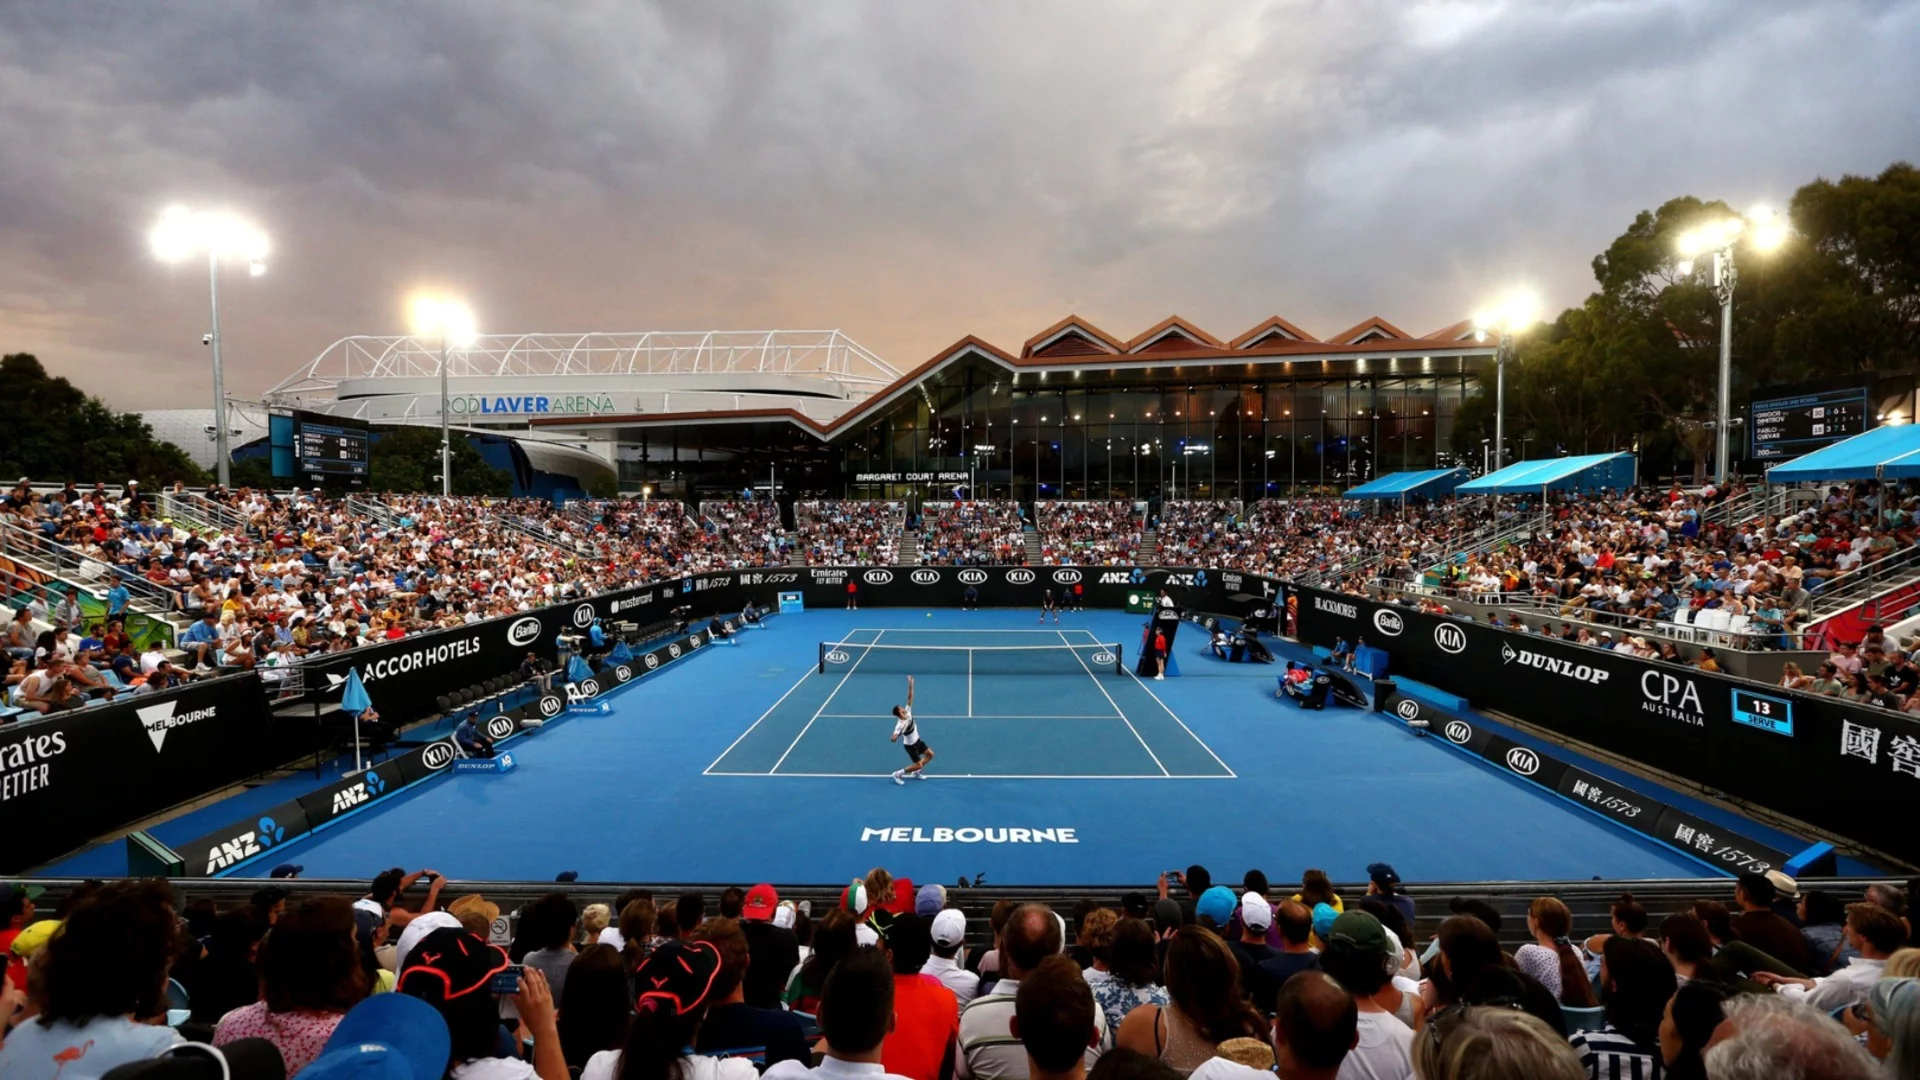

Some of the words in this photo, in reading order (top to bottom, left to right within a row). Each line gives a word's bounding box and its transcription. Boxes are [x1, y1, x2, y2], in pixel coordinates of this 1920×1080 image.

[481, 397, 549, 413] LAVER
[551, 396, 615, 412] ARENA
[856, 473, 902, 481] MARGARET
[938, 472, 969, 481] ARENA
[811, 569, 848, 578] Emirates
[868, 573, 888, 581] KIA
[915, 573, 935, 581] KIA
[963, 573, 982, 581] KIA
[1010, 573, 1030, 581] KIA
[1058, 573, 1077, 581] KIA
[1099, 572, 1130, 584] ANZ
[620, 592, 653, 610] mastercard
[1314, 597, 1357, 619] BLACKMORES
[577, 608, 593, 623] KIA
[1379, 615, 1400, 630] Barilla
[516, 622, 538, 638] Barilla
[1439, 627, 1461, 649] KIA
[362, 654, 423, 683] ACCOR
[426, 636, 480, 667] HOTELS
[1517, 650, 1610, 684] DUNLOP
[1641, 670, 1704, 714] CPA
[543, 699, 558, 712] KIA
[1400, 703, 1415, 716] KIA
[1752, 700, 1771, 715] 13
[146, 706, 216, 733] MELBOURNE
[1642, 701, 1704, 727] AUSTRALIA
[1748, 715, 1776, 729] SERVE
[491, 719, 511, 735] KIA
[1449, 726, 1467, 741] KIA
[426, 746, 450, 765] KIA
[1510, 752, 1534, 772] KIA
[0, 763, 49, 801] ETTER
[332, 782, 370, 815] ANZ
[860, 827, 1079, 843] MELBOURNE
[206, 831, 261, 875] ANZ
